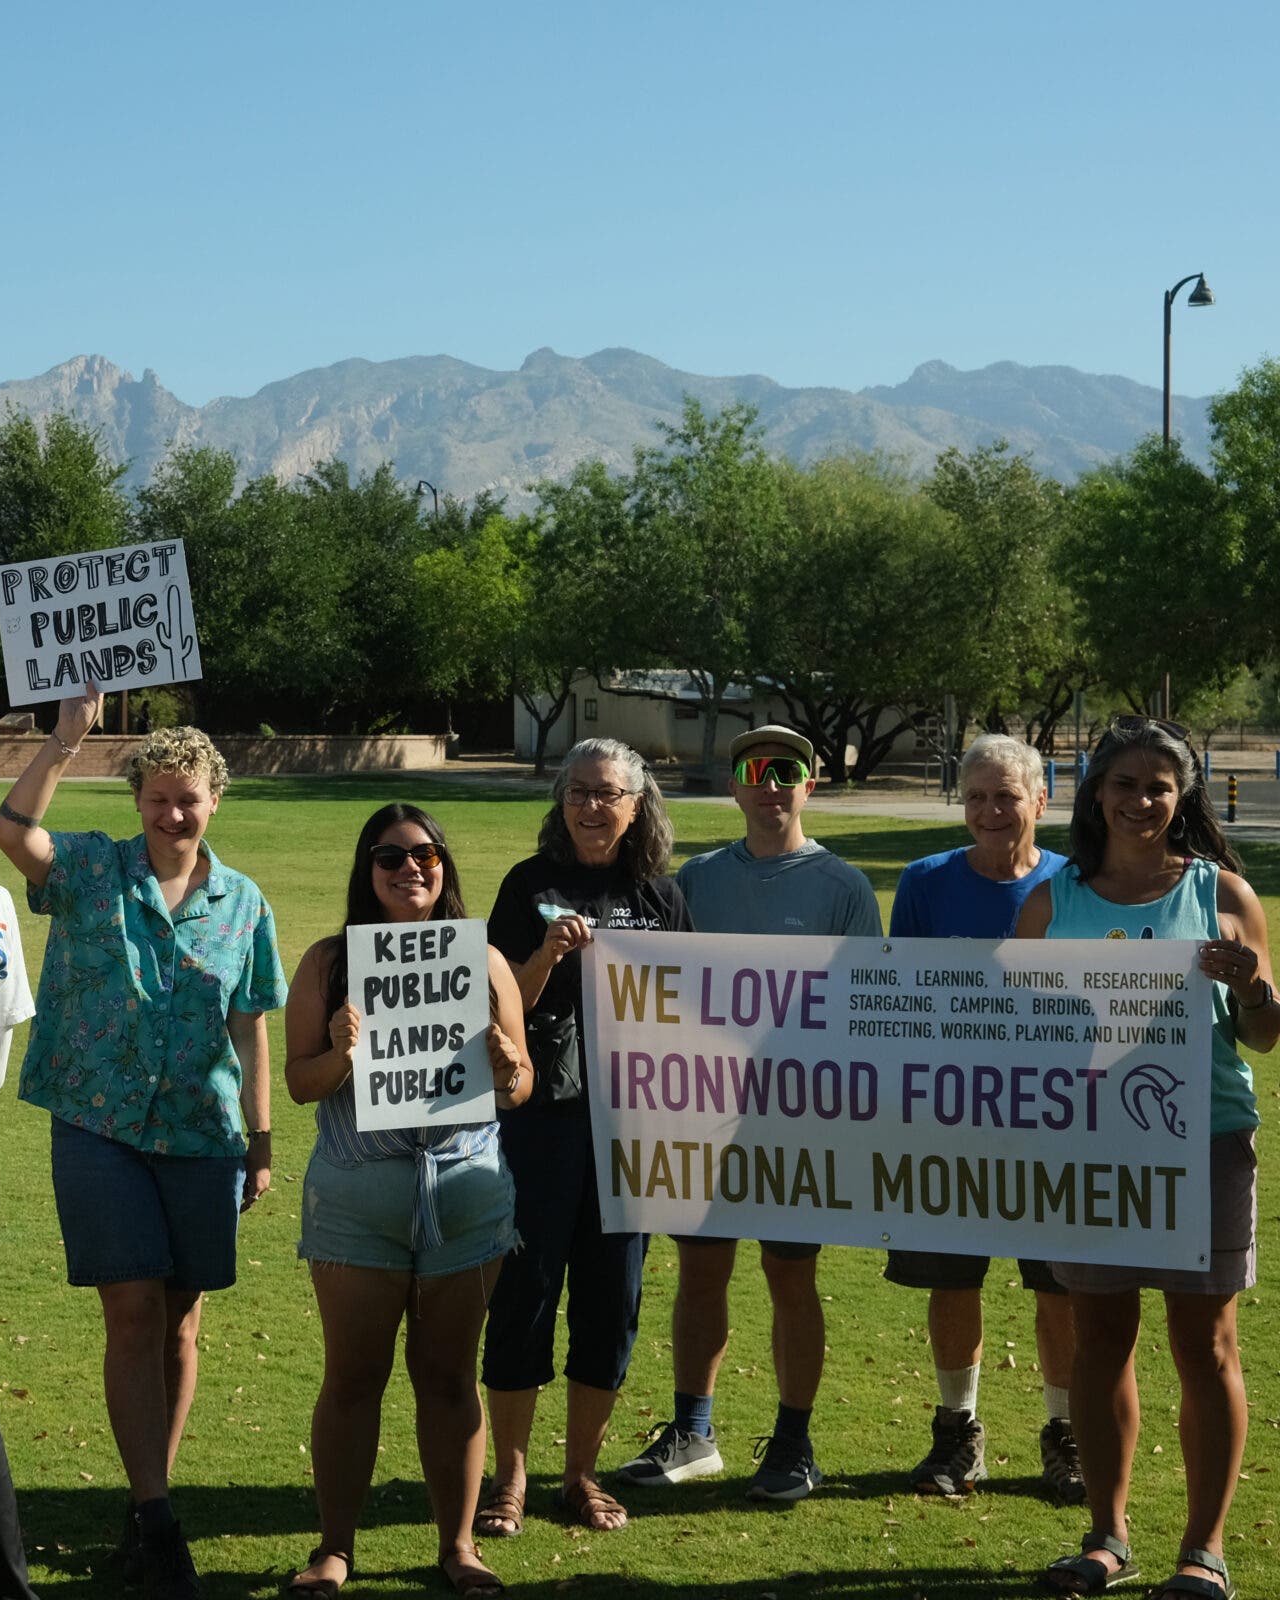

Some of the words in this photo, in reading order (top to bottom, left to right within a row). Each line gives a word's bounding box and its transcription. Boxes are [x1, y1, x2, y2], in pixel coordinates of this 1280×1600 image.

[1, 543, 176, 606] PROTECT
[30, 593, 158, 648] PUBLIC
[26, 638, 157, 690] LANDS
[611, 907, 633, 918] 022
[374, 926, 456, 964] KEEP
[364, 965, 471, 1016] PUBLIC
[607, 963, 682, 1024] WE
[700, 967, 829, 1029] LOVE
[850, 969, 901, 987] HIKING,
[915, 970, 988, 988] LEARNING,
[1003, 971, 1068, 990] HUNTING,
[1083, 972, 1188, 991] RESEARCHING,
[849, 994, 936, 1013] STARGAZING,
[950, 996, 1018, 1015] CAMPING,
[1033, 998, 1095, 1016] BIRDING,
[1109, 1000, 1189, 1019] RANCHING,
[369, 1022, 465, 1061] LANDS
[849, 1020, 936, 1039] PROTECTING,
[940, 1022, 1010, 1041] WORKING,
[1015, 1024, 1078, 1043] PLAYING,
[1083, 1026, 1112, 1043] AND
[1117, 1026, 1166, 1045] LIVING
[1171, 1027, 1187, 1046] IN
[369, 1062, 466, 1106] PUBLIC
[610, 1051, 878, 1121] IRONWOOD
[902, 1063, 1107, 1131] FOREST
[610, 1138, 852, 1210] NATIONAL
[872, 1152, 1186, 1230] MONUMENT
